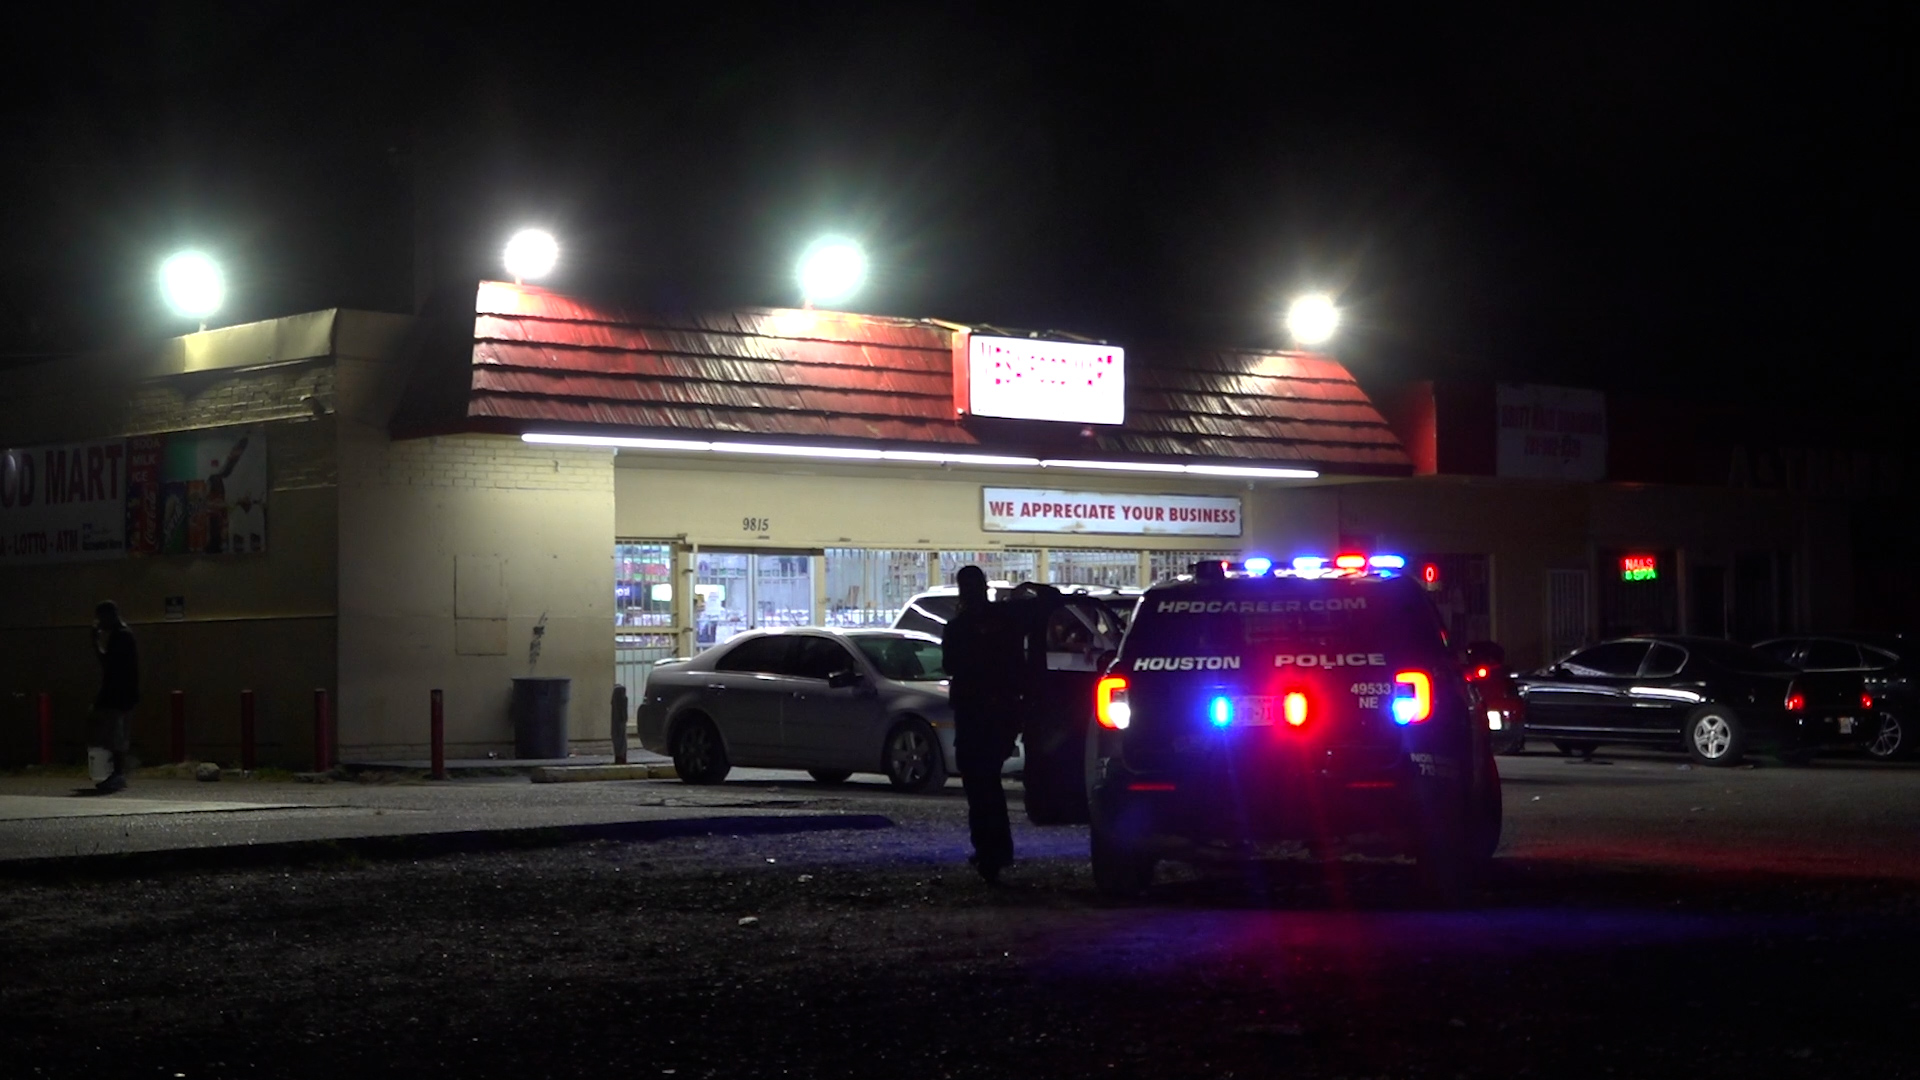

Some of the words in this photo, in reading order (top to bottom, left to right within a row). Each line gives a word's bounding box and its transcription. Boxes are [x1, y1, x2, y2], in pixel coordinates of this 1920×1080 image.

[45, 444, 123, 505] MART
[989, 501, 1014, 517] WE
[1020, 502, 1116, 520] APPRECIATE
[1121, 506, 1165, 522] YOUR
[1169, 508, 1236, 523] BUSINESS
[742, 517, 769, 531] 9815
[14, 532, 47, 555] LOTTO
[57, 529, 78, 553] ATM
[1624, 558, 1654, 570] NAILS
[1157, 597, 1367, 614] HPDCAREER.COM
[1133, 656, 1241, 671] HOUSTON
[1274, 654, 1386, 668] POLICE
[1350, 682, 1391, 695] 49533
[1359, 696, 1379, 709] NE
